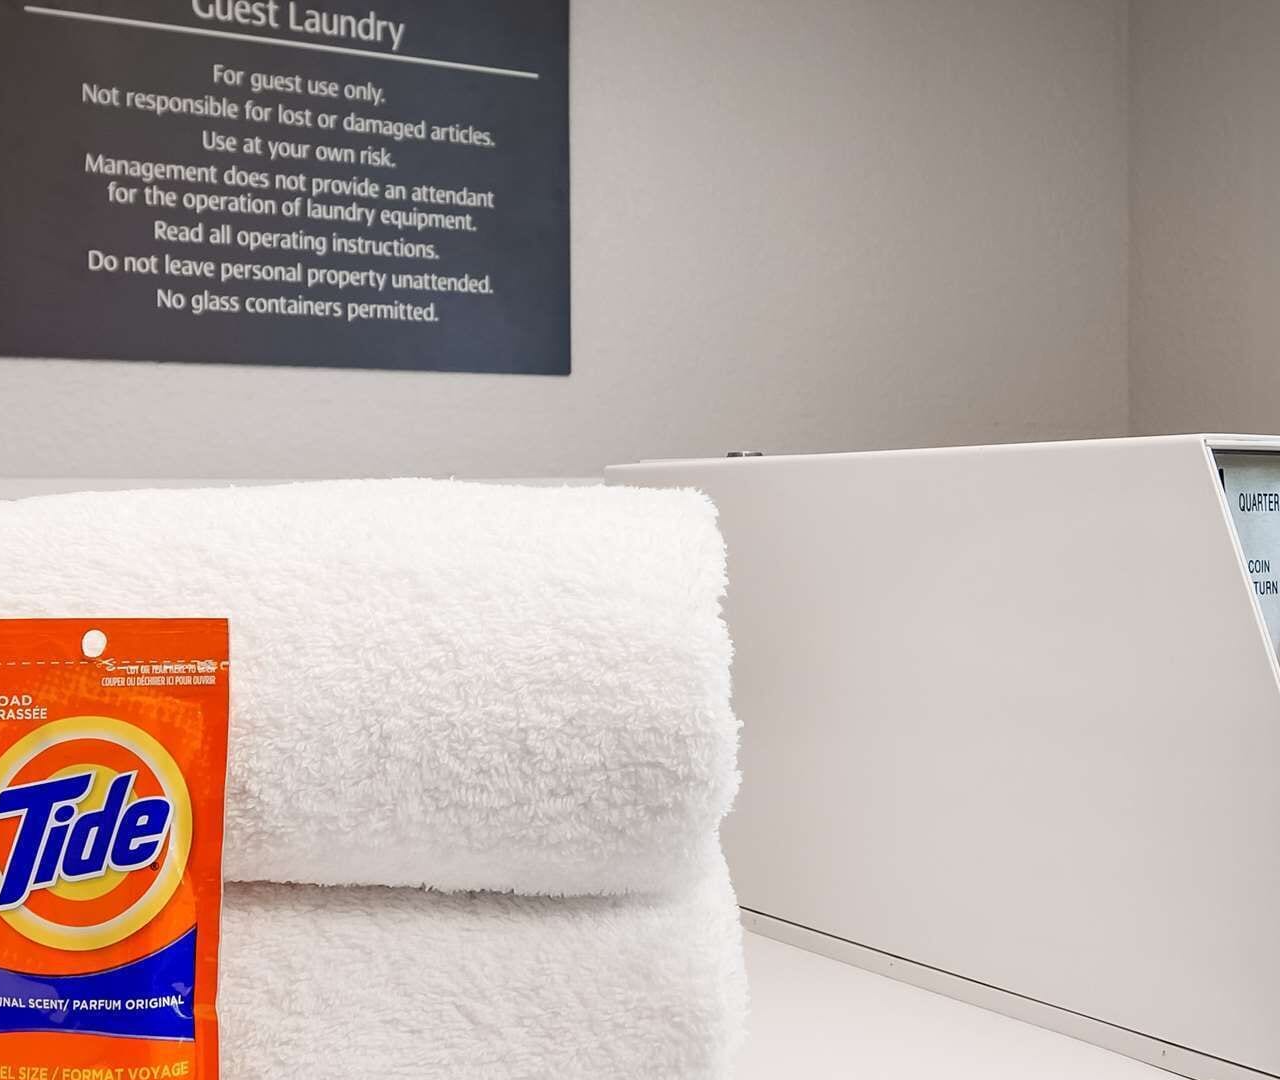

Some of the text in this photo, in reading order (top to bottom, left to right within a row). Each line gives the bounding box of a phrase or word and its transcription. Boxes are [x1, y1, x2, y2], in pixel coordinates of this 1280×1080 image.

[191, 0, 406, 51] Guest Laundry
[213, 64, 387, 107] For guest use only.
[81, 82, 496, 147] Not responsible for lost or damaged articles.
[202, 129, 397, 168] Use at your own risk.
[84, 153, 495, 209] Management does not provide an attendant
[107, 181, 477, 232] for the operation of laundry equipment.
[154, 219, 440, 260] Read all operating instructions.
[88, 249, 494, 294] Do not leave personal property unattended.
[156, 288, 440, 323] No glass containers permitted.
[1248, 559, 1271, 574] COIN
[1253, 580, 1279, 595] TURN
[72, 999, 122, 1011] PARFUM
[125, 994, 185, 1010] ORIGINAL
